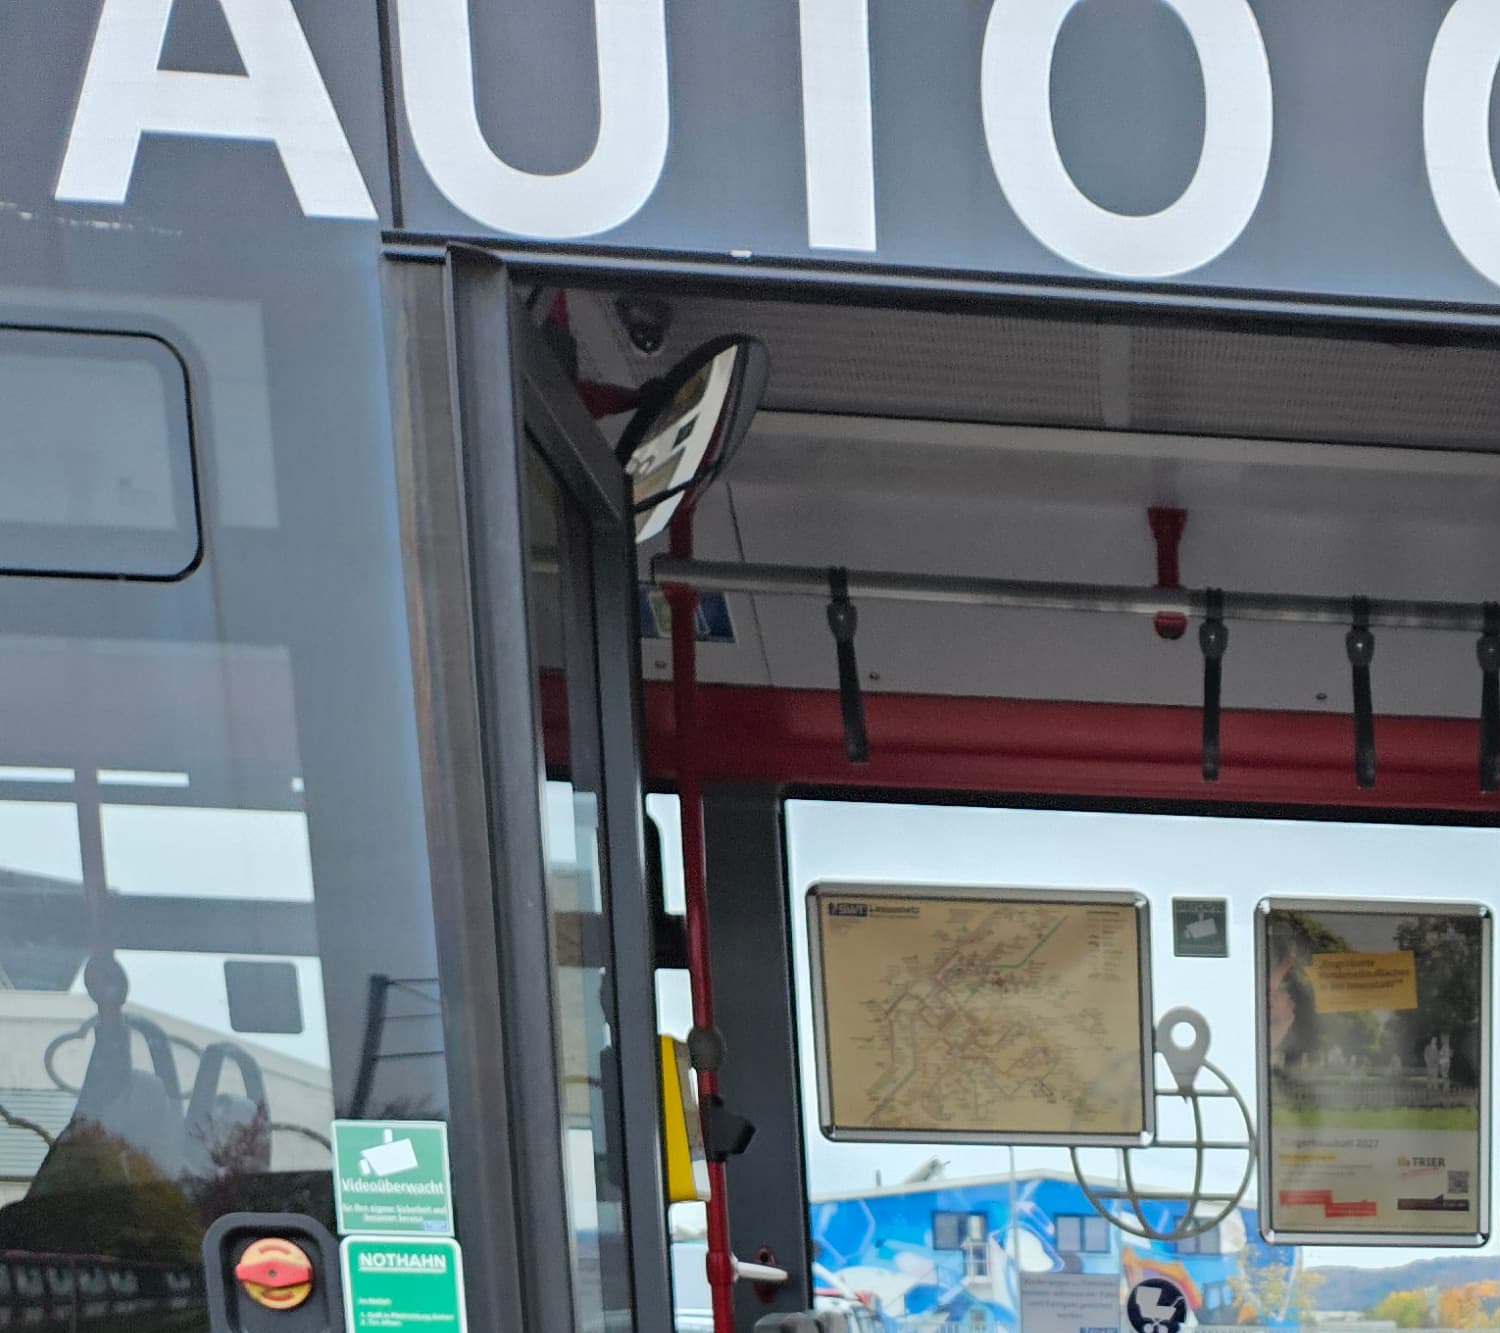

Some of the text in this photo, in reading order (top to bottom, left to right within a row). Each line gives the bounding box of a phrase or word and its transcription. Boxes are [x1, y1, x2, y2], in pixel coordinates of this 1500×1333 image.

[55, 0, 1273, 278] AUTO
[1411, 1156, 1446, 1168] TRIER
[341, 1177, 444, 1195] Videoüberwacht
[358, 1252, 447, 1268] NOTHAHN
